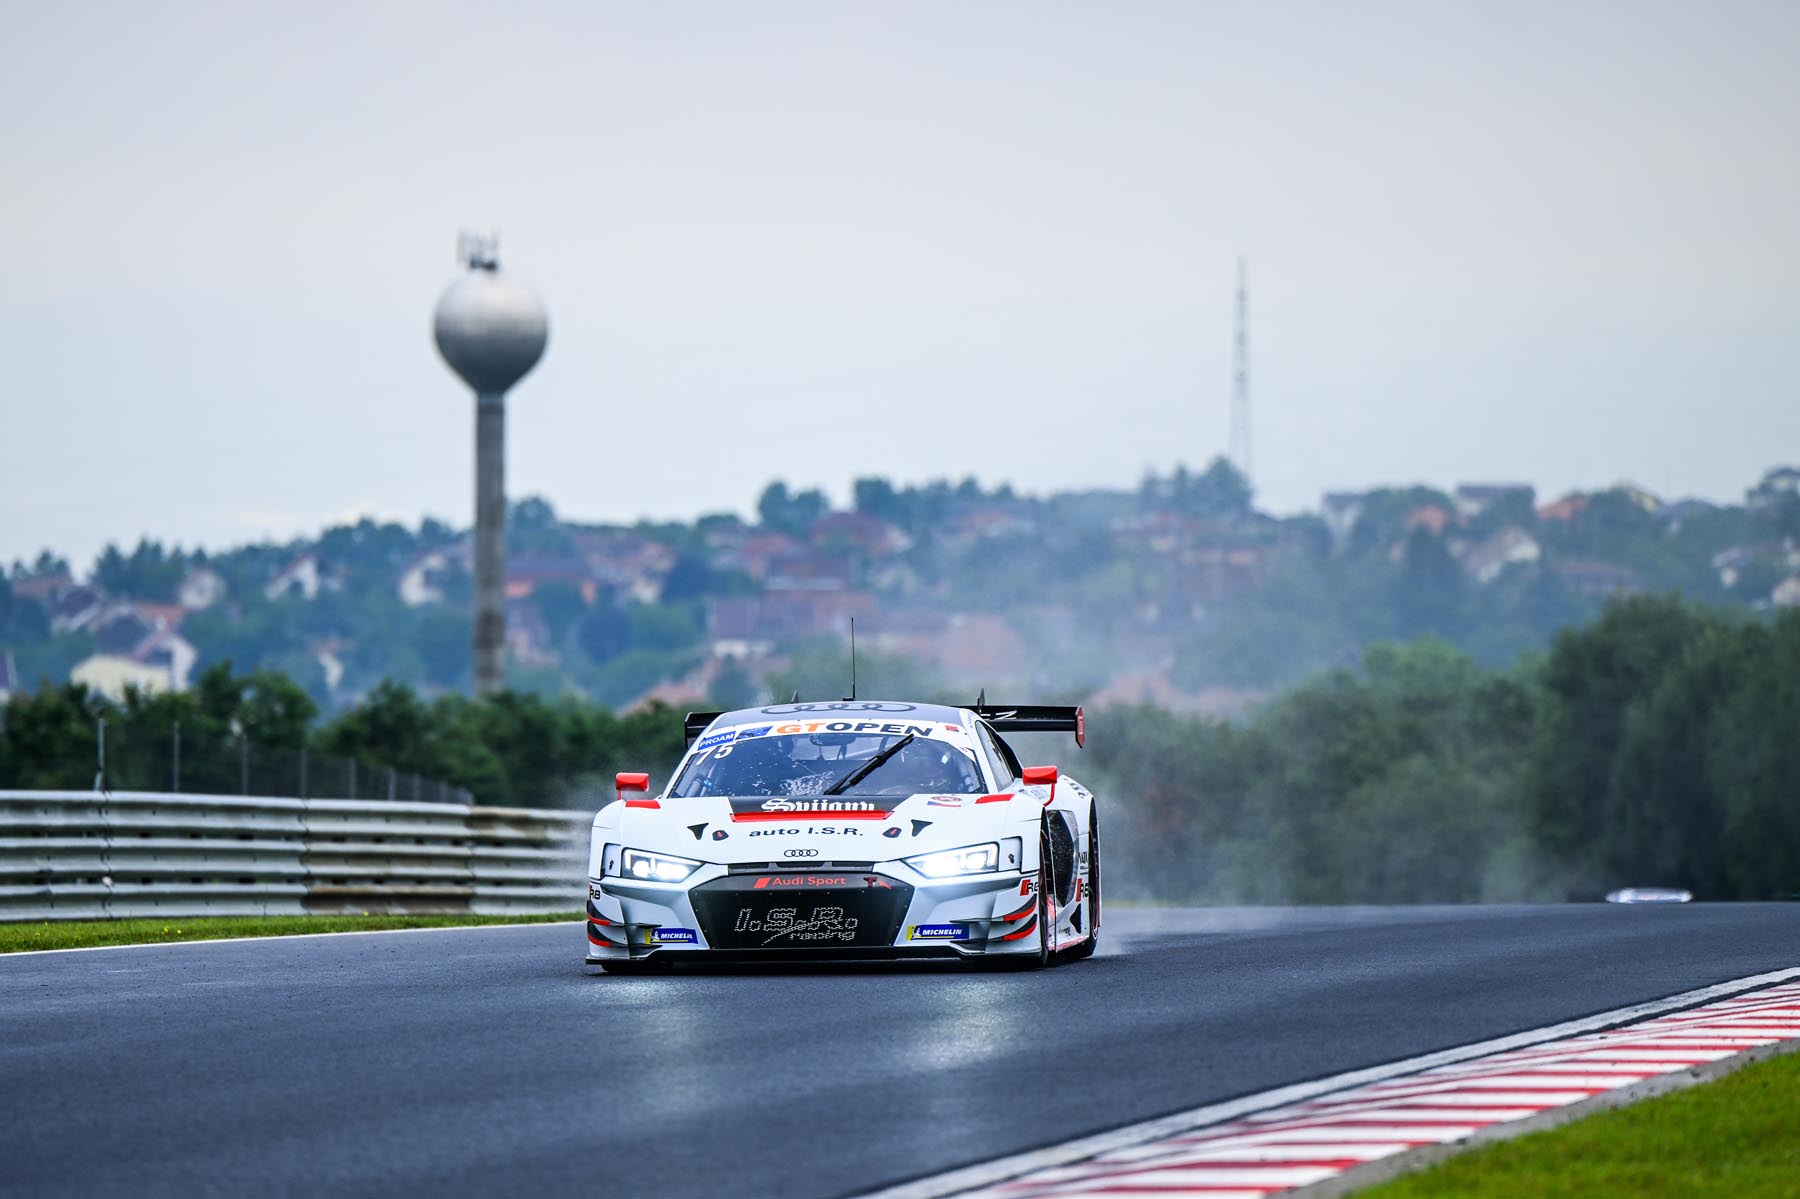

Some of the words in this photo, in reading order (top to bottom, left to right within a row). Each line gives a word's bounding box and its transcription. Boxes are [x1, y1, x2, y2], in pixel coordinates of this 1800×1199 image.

[700, 733, 734, 747] PROAM
[695, 744, 734, 766] 75
[748, 827, 800, 837] auto
[807, 827, 863, 837] I.S.R.
[772, 876, 803, 886] Audi
[807, 876, 847, 888] Sport
[660, 932, 693, 940] MICHELIN
[922, 928, 962, 936] MICHELIN
